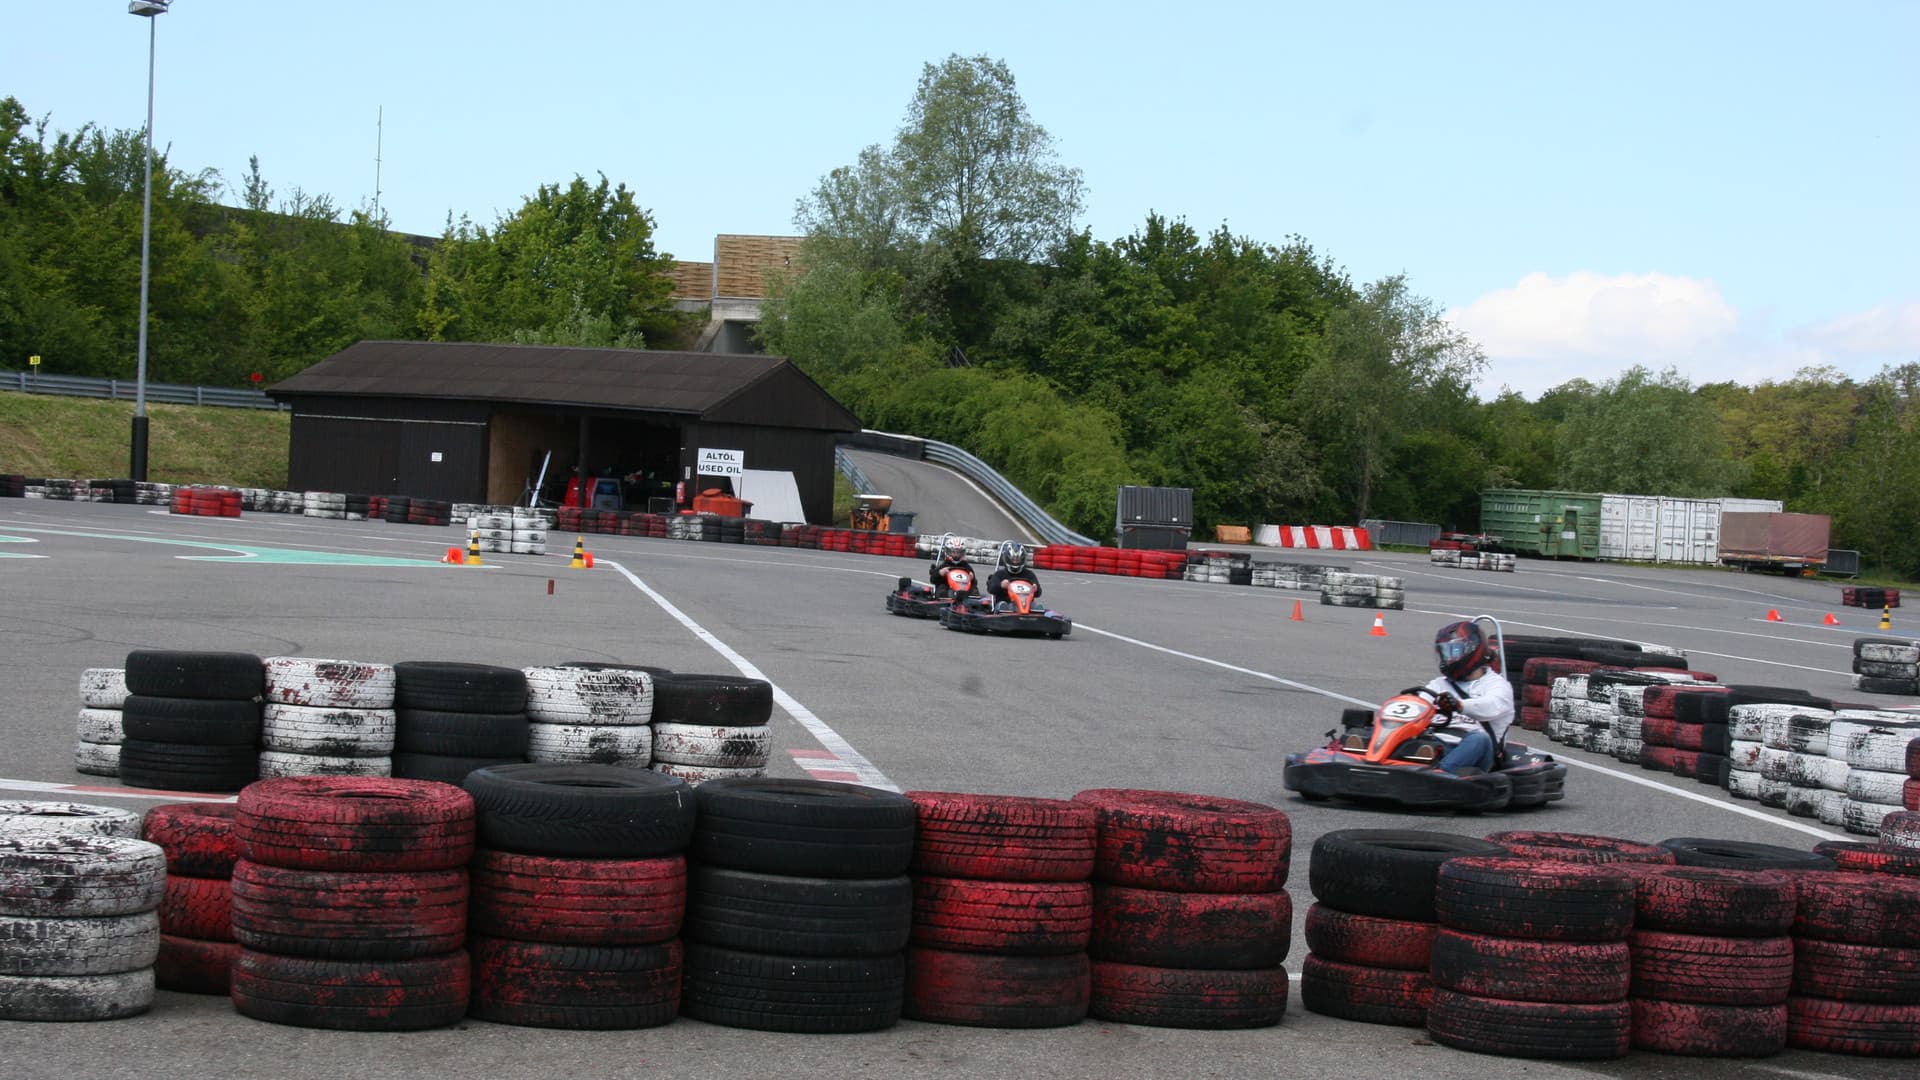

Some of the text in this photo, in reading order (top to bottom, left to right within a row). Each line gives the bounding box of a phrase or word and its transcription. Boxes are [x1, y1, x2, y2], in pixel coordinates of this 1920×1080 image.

[698, 464, 742, 474] USED OIL
[1392, 704, 1410, 714] 3
